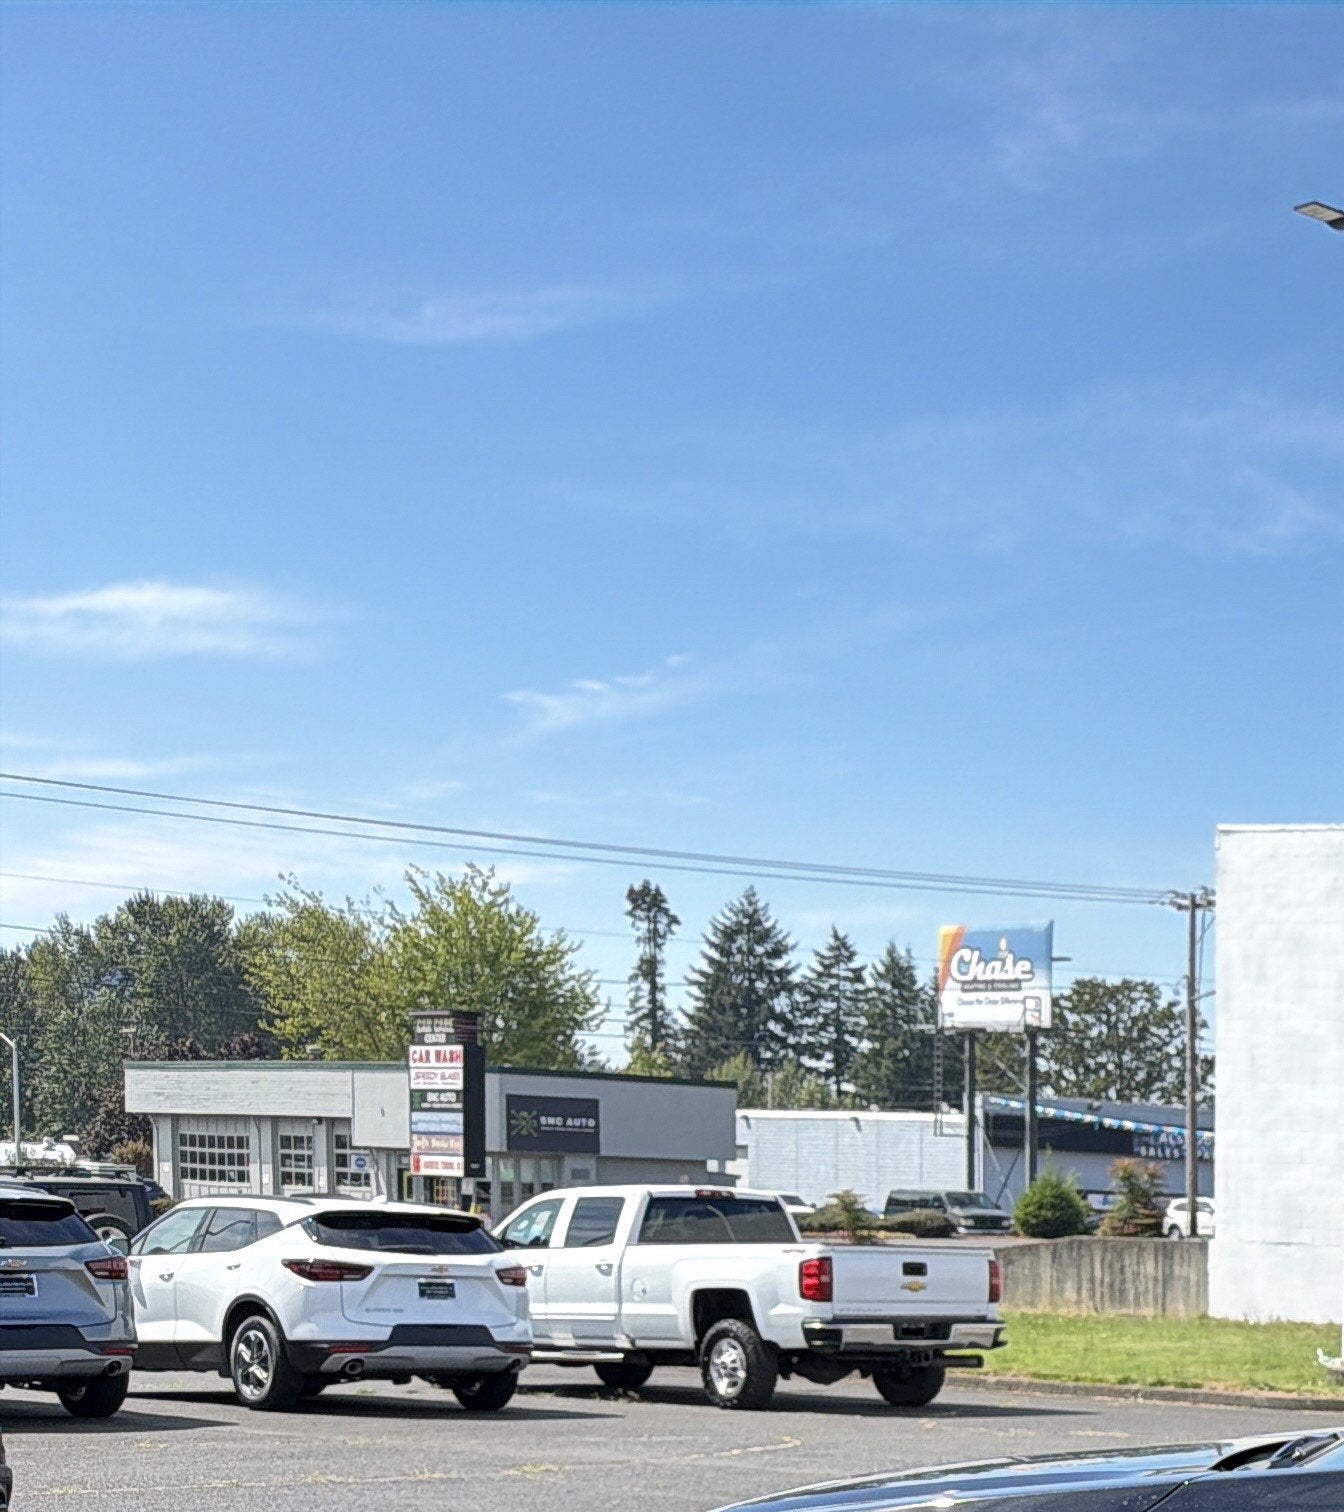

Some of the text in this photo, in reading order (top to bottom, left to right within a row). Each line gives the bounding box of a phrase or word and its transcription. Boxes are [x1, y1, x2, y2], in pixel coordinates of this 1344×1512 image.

[949, 947, 1034, 981] Chase
[411, 1049, 462, 1064] CAR WASH
[565, 1117, 596, 1128] AUTO
